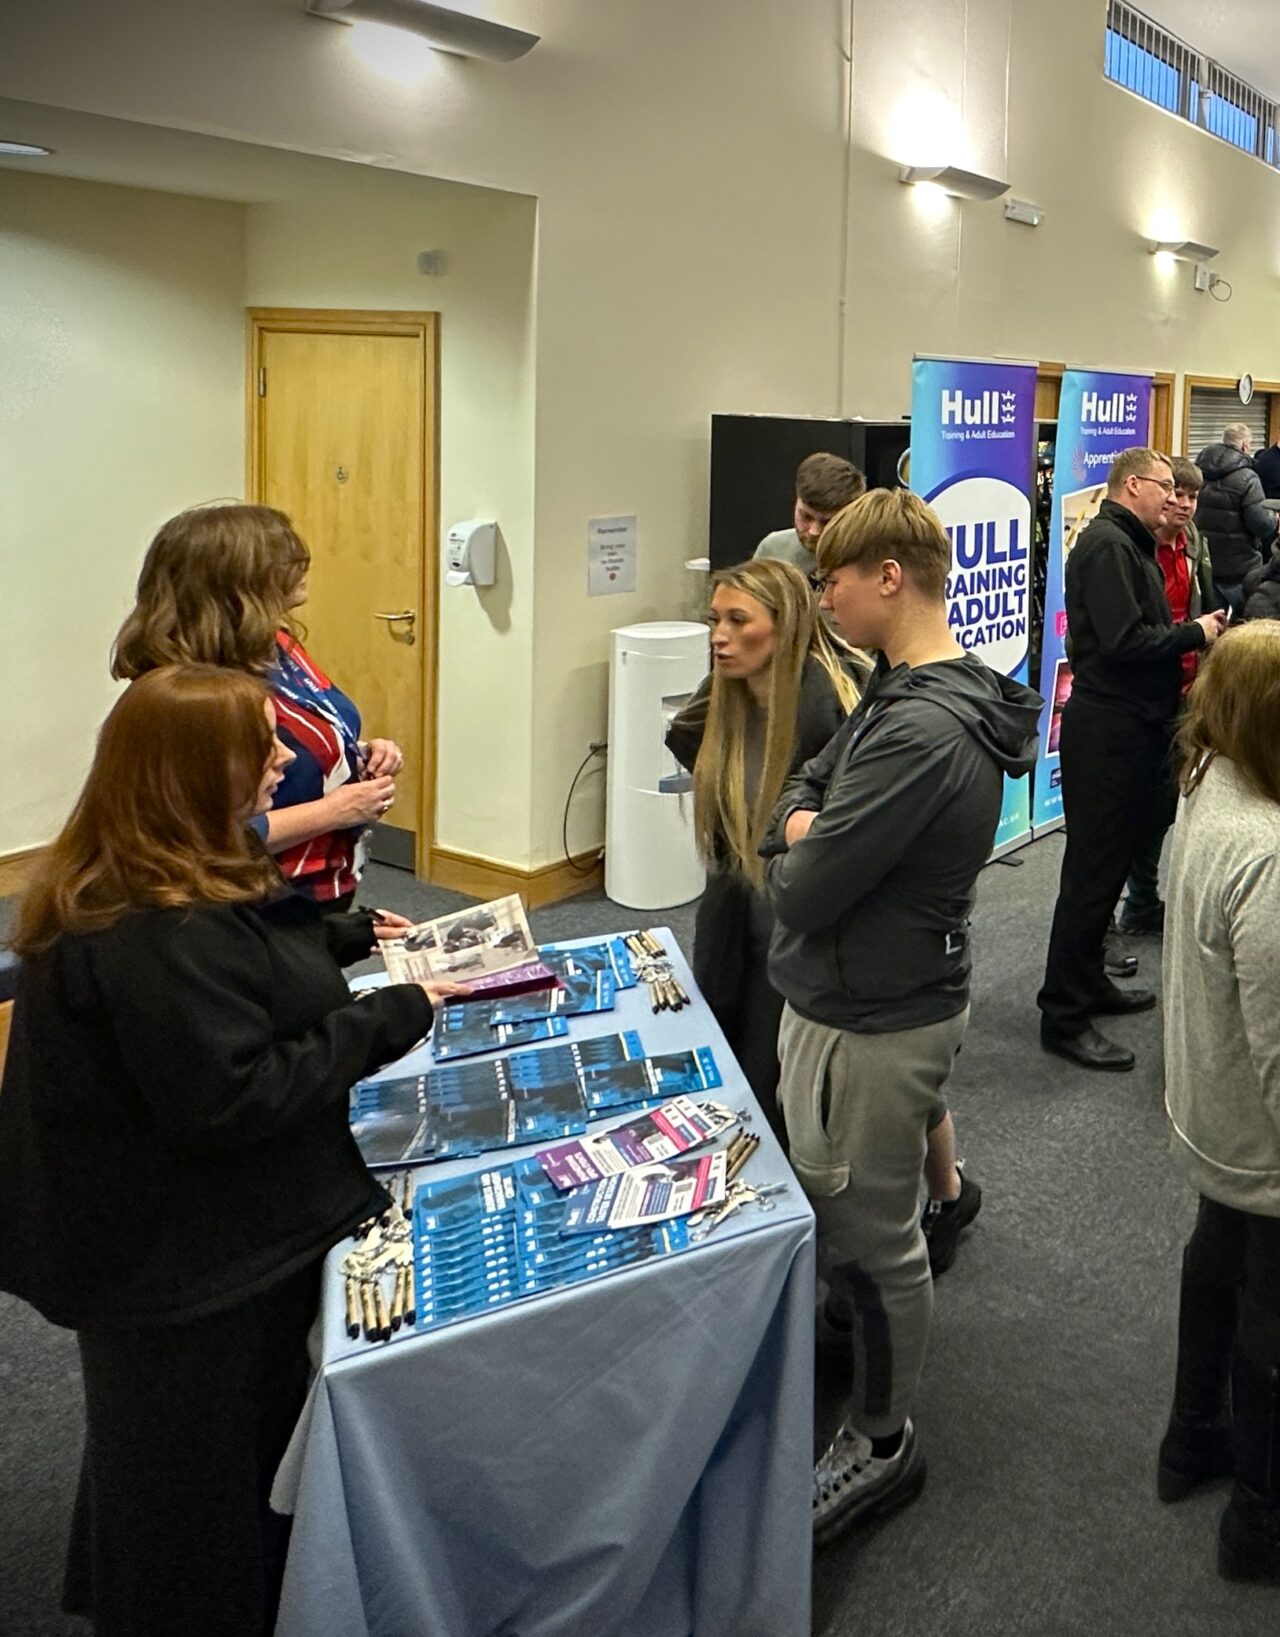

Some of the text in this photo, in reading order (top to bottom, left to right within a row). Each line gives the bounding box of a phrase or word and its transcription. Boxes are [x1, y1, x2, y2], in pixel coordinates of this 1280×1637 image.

[942, 389, 1000, 425] Hull
[1081, 391, 1125, 422] Hull
[941, 430, 965, 441] Training
[971, 430, 986, 439] Adult
[987, 430, 1016, 438] Education
[945, 519, 1028, 570] ULL
[945, 563, 1026, 600] RAINING
[956, 617, 1026, 650] CATION
